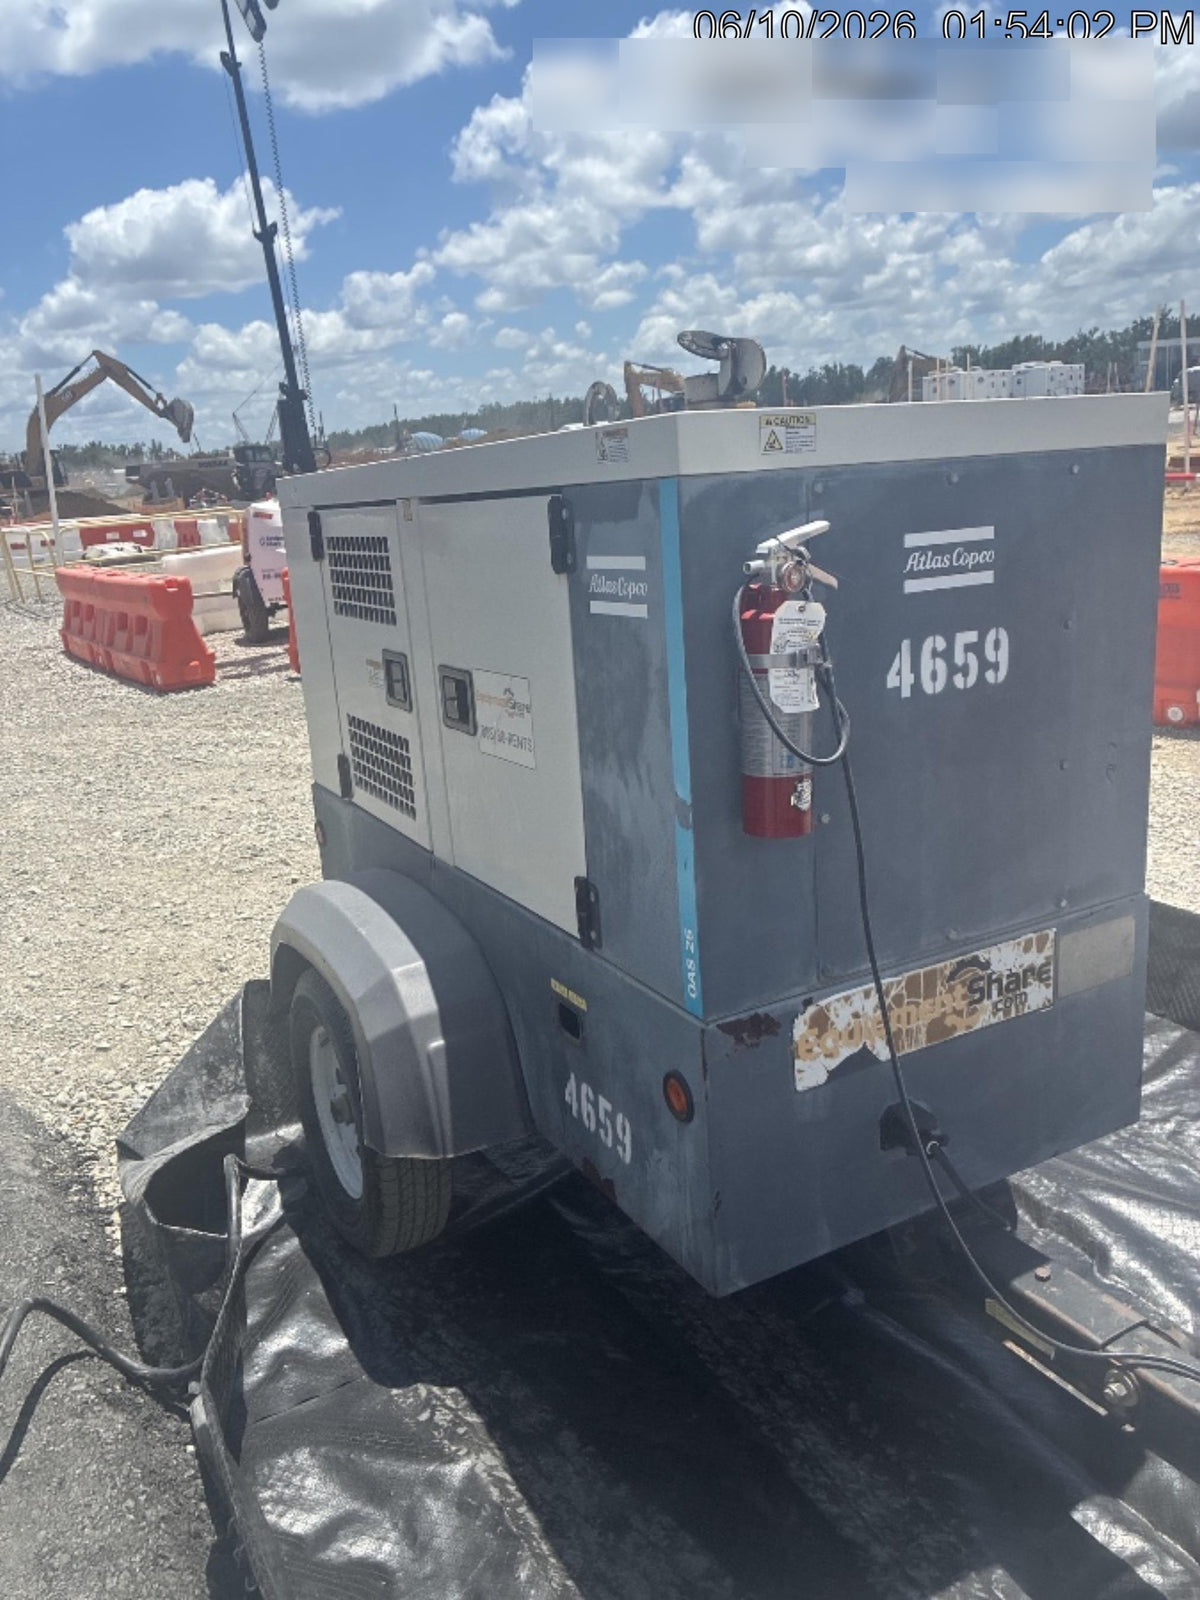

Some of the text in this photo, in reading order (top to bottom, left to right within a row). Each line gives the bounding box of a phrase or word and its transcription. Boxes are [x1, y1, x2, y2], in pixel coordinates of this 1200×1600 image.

[902, 547, 995, 573] Atlas Copco
[588, 573, 648, 599] Atlas Copco
[886, 626, 1010, 699] 4659
[565, 1071, 632, 1165] 4659
